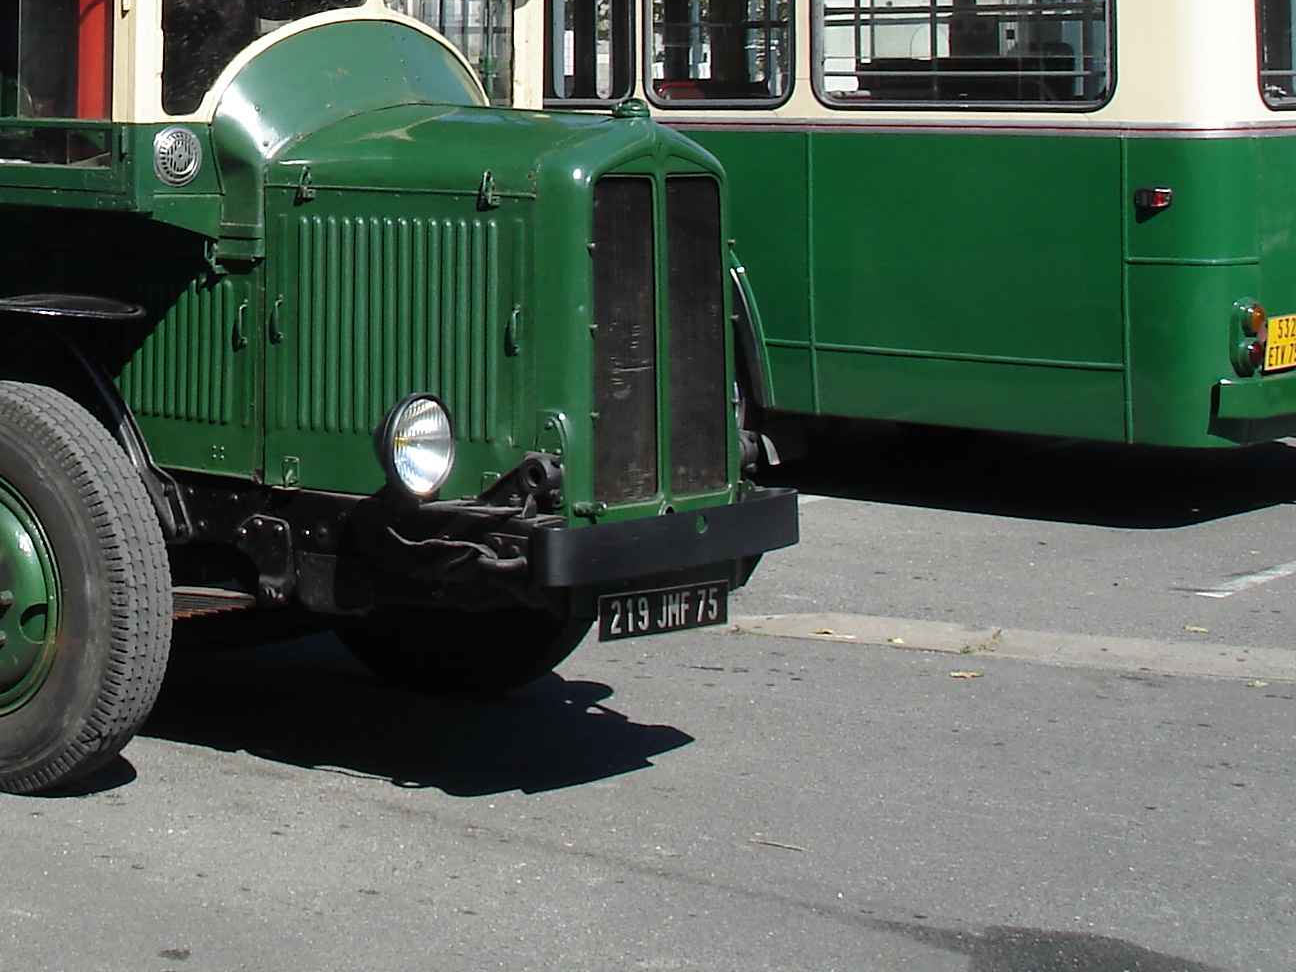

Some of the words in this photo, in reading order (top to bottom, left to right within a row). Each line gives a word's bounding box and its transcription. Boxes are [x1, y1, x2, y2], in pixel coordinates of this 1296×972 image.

[1278, 317, 1295, 339] 532
[610, 597, 649, 634] 219
[657, 591, 690, 628] JMF
[697, 588, 718, 622] 75
